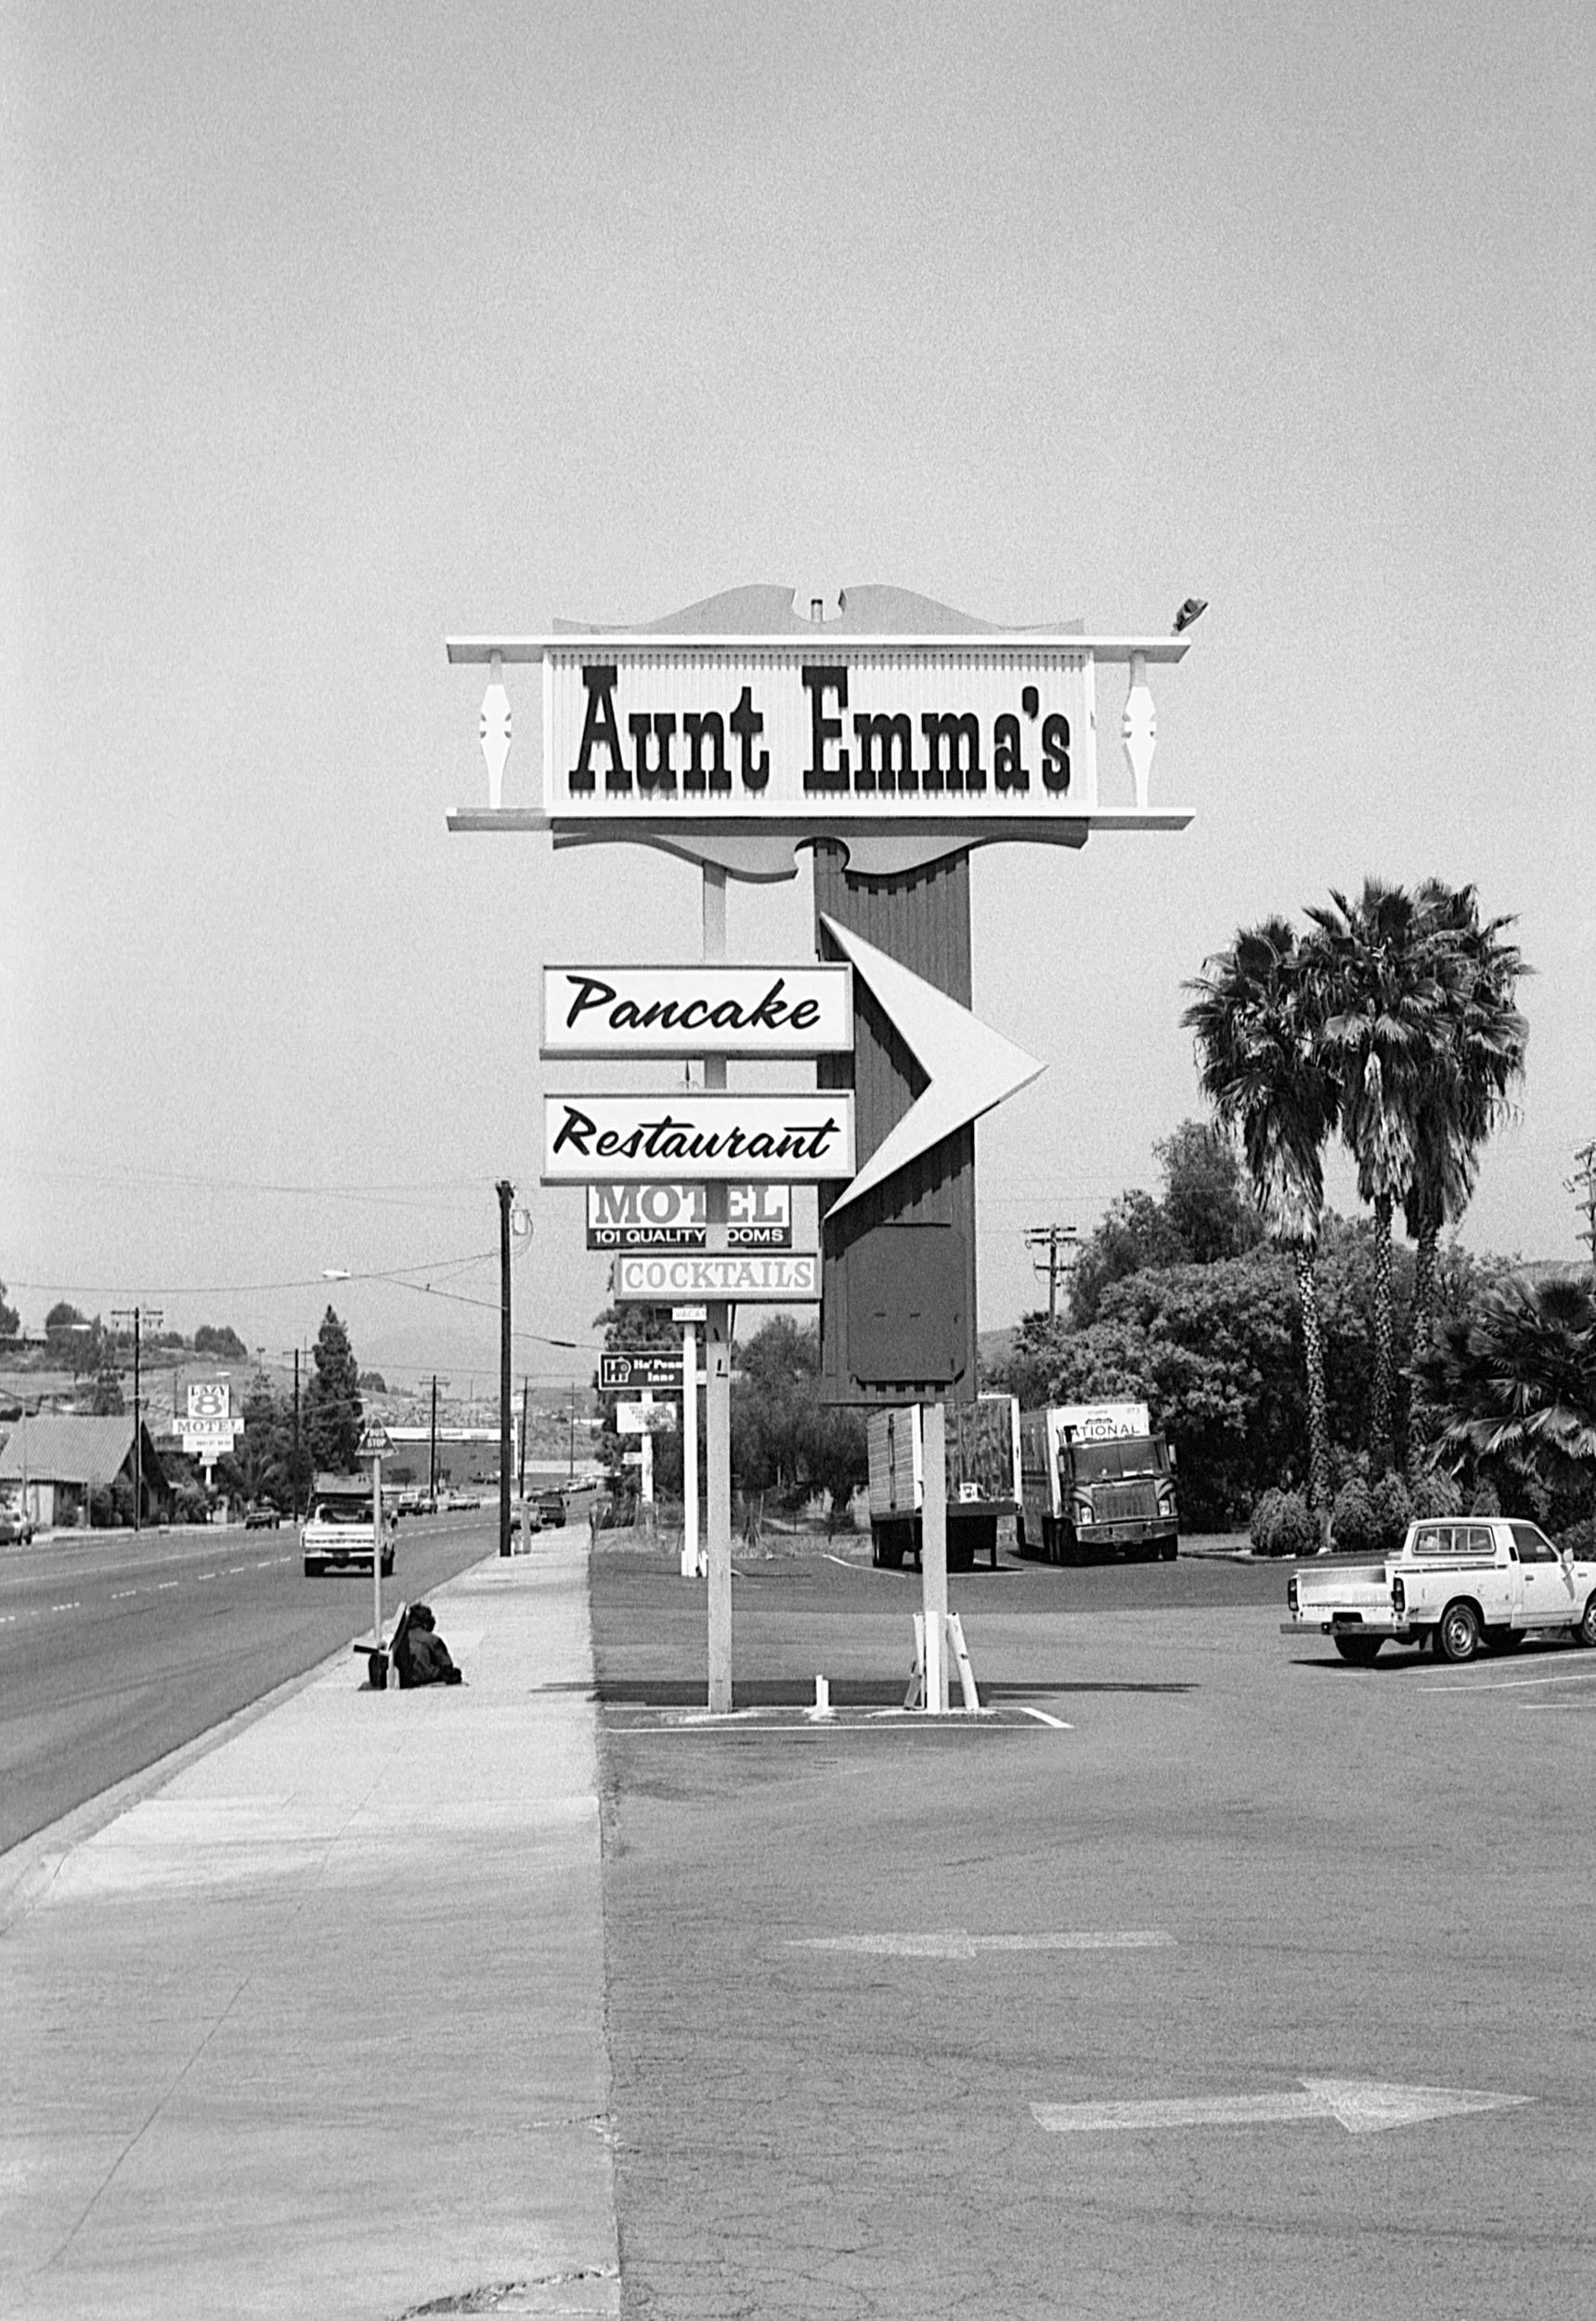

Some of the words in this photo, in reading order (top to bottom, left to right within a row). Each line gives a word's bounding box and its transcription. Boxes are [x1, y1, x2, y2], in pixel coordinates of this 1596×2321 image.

[568, 665, 770, 793] Aunt
[801, 665, 1071, 793] Emma's
[565, 974, 822, 1030] Pancake
[552, 1105, 841, 1159] Restaurant
[595, 1185, 784, 1225] MOTEL
[595, 1229, 621, 1243] 101
[626, 1228, 707, 1243] QUALITY
[727, 1228, 785, 1242] OOMS
[624, 1261, 812, 1290] COCKTAILS
[194, 1394, 223, 1416] 8
[177, 1420, 241, 1433] MOTEL
[369, 1428, 384, 1437] BUS
[1070, 1423, 1141, 1438] ATIONAL
[367, 1438, 387, 1448] STOP
